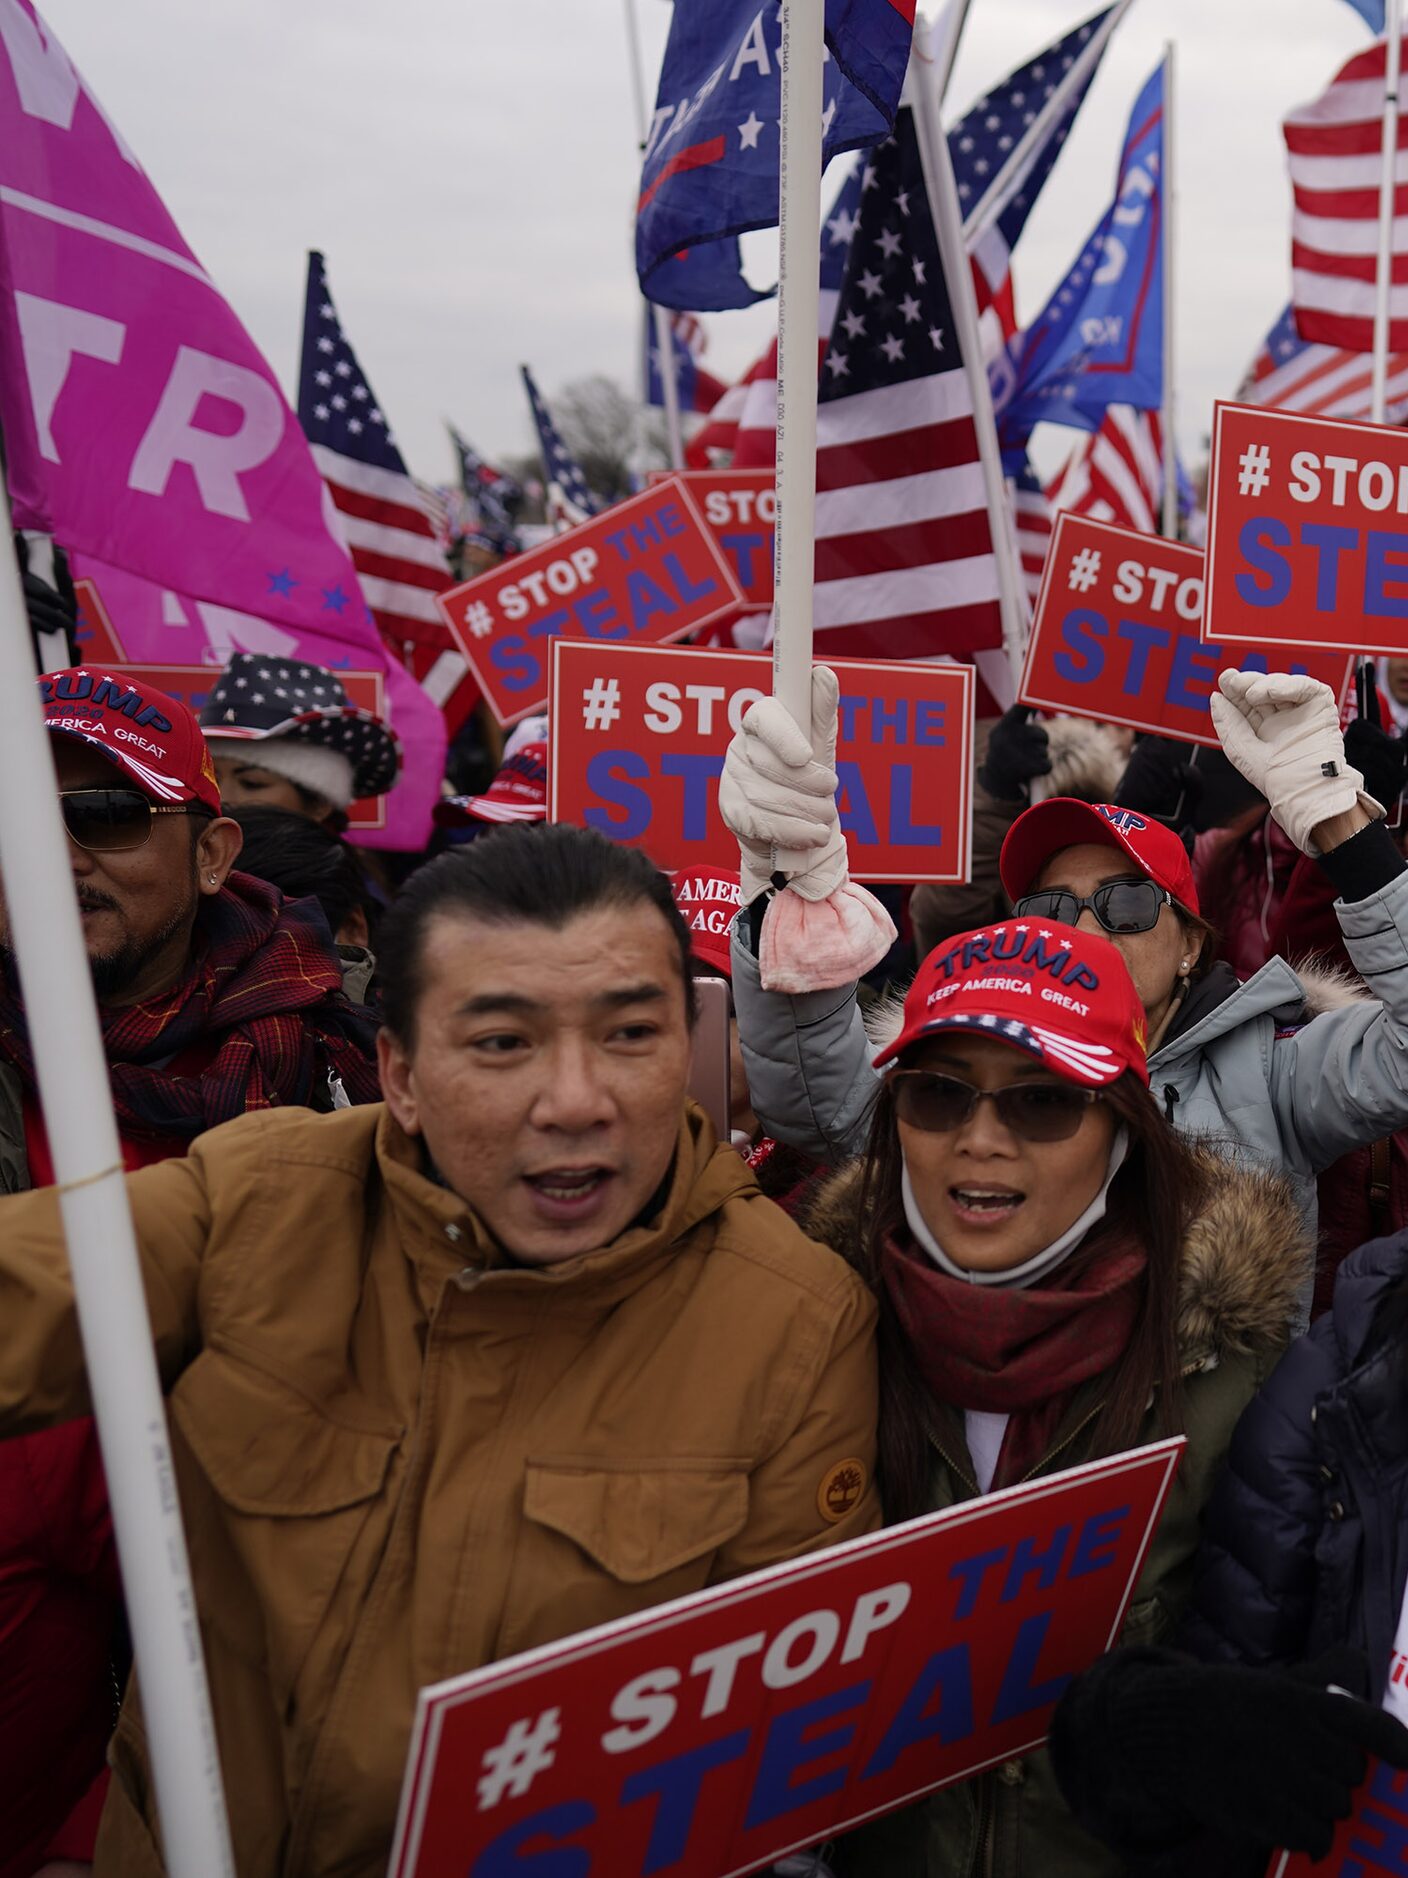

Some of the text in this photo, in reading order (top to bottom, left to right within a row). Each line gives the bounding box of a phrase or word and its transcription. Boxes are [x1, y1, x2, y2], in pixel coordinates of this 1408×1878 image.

[1238, 444, 1271, 497] #
[705, 490, 776, 524] STO
[498, 547, 598, 620] STOP
[604, 504, 687, 561] THE
[1113, 560, 1201, 619] STO
[48, 706, 104, 719] 2020
[582, 678, 621, 730] #
[839, 695, 946, 746] THE
[114, 728, 167, 759] GREAT
[935, 931, 1098, 991] TRUMP
[982, 964, 1036, 979] 2020
[927, 978, 1091, 1017] KEEP AMERICA GREAT
[478, 1505, 1131, 1811] # STOP THE
[471, 1612, 1077, 1878] STEAL
